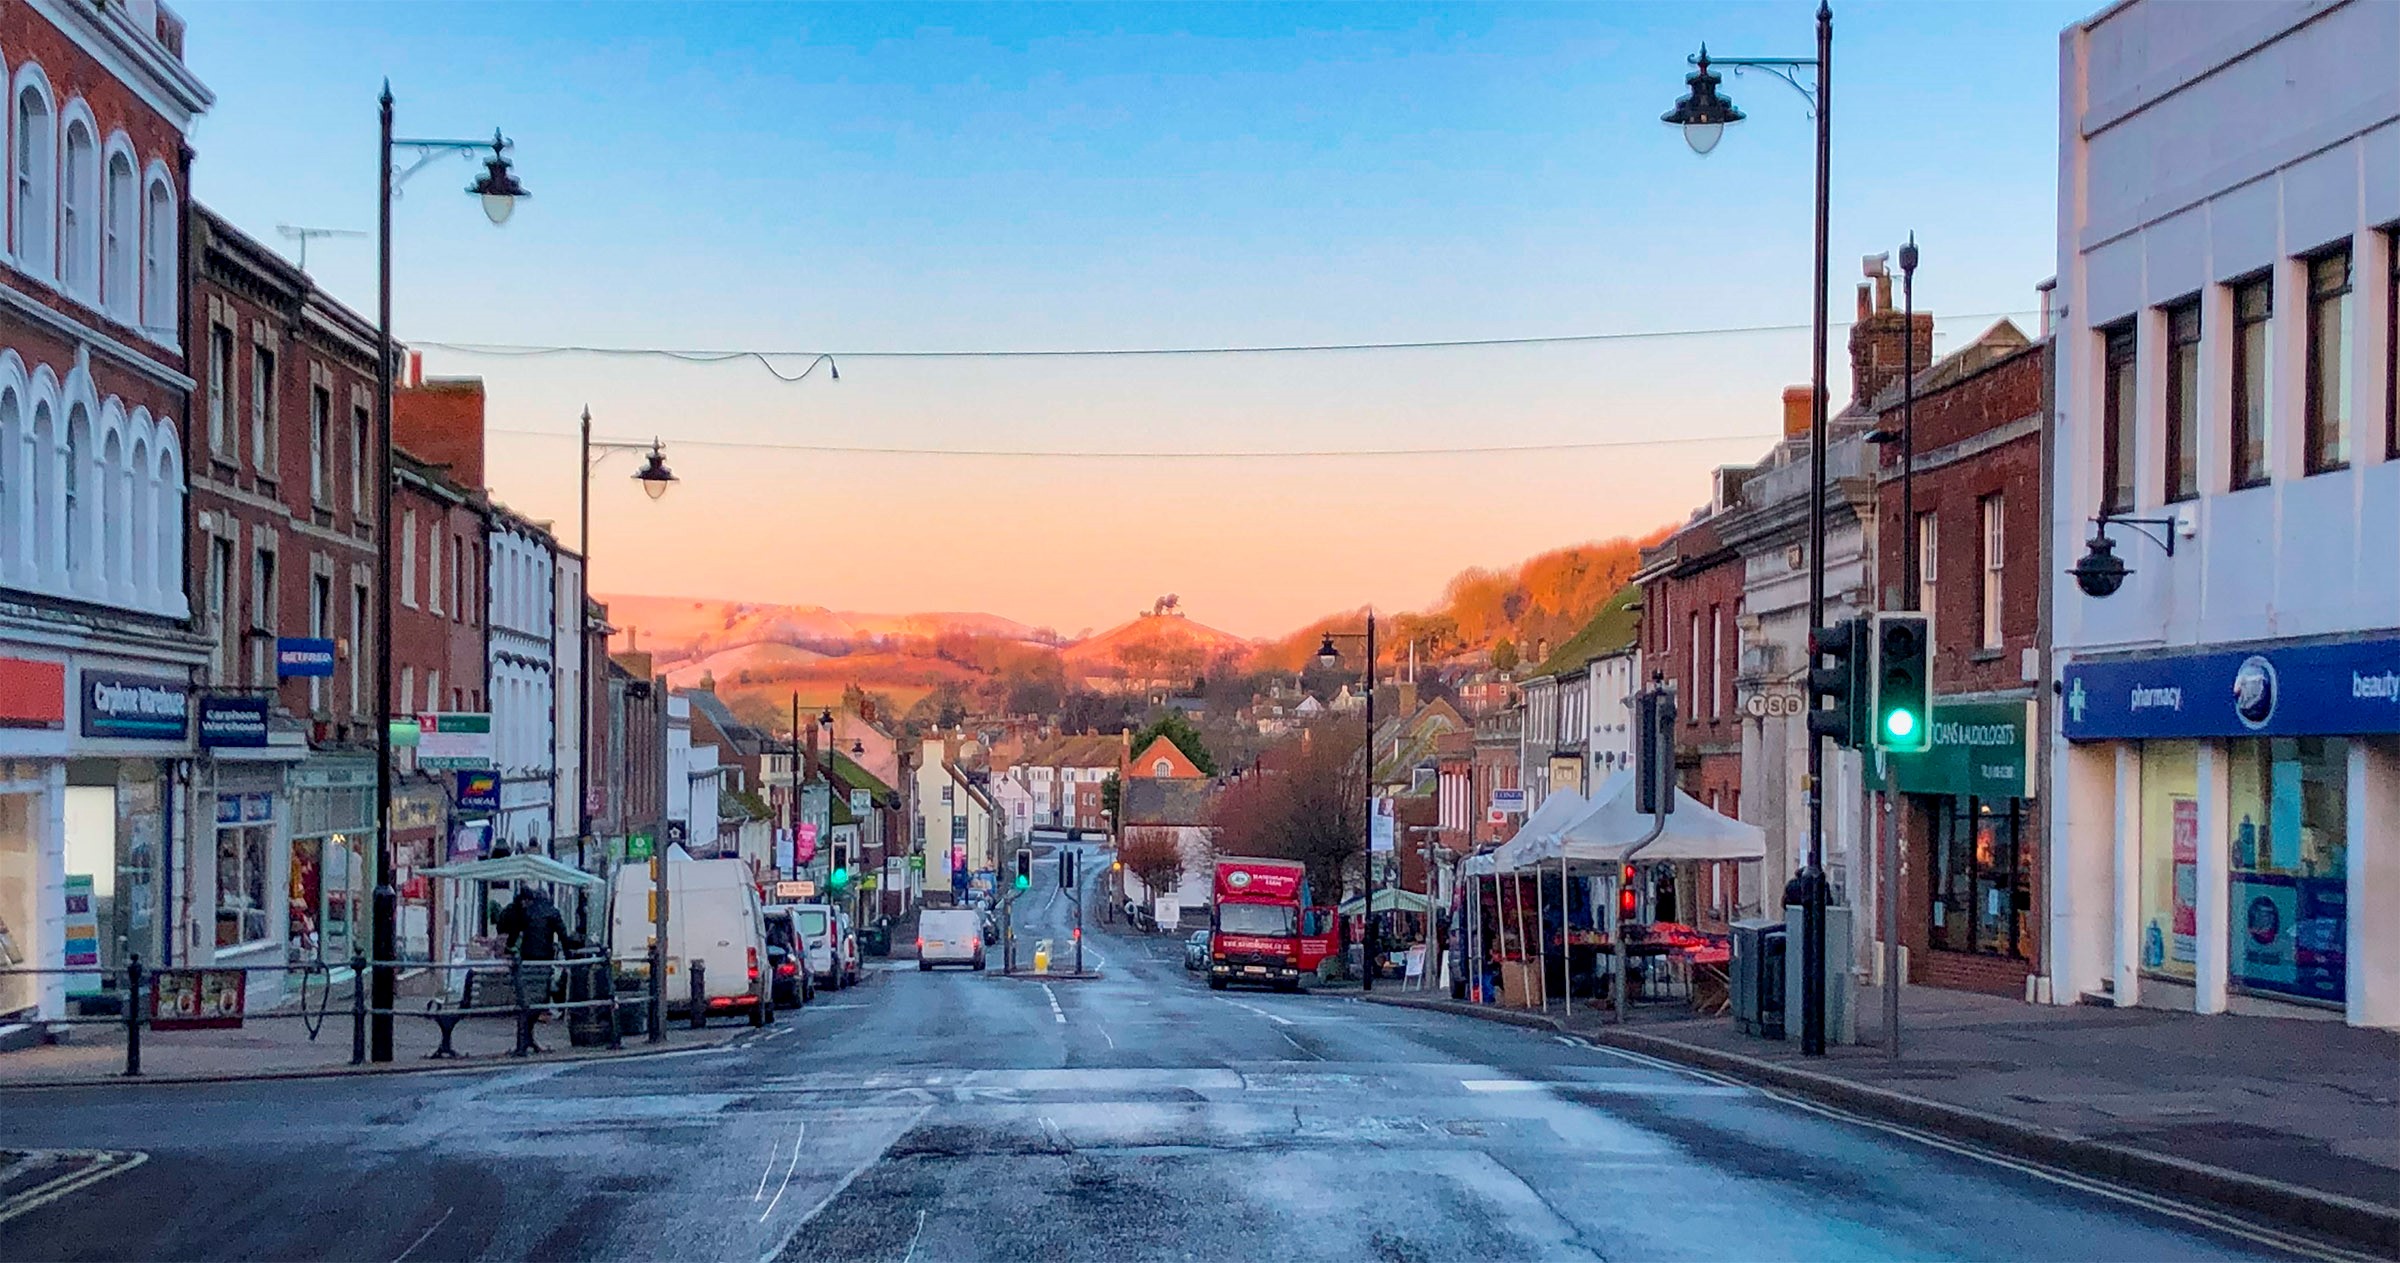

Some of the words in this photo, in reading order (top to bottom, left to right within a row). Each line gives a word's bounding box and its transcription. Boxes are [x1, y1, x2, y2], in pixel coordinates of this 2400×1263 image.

[2352, 669, 2399, 702] beauty
[2131, 682, 2182, 711] pharmacy
[1753, 699, 1798, 713] TSB
[206, 709, 260, 721] Carphone
[201, 721, 266, 731] Warehouse
[461, 797, 496, 807] CORAL
